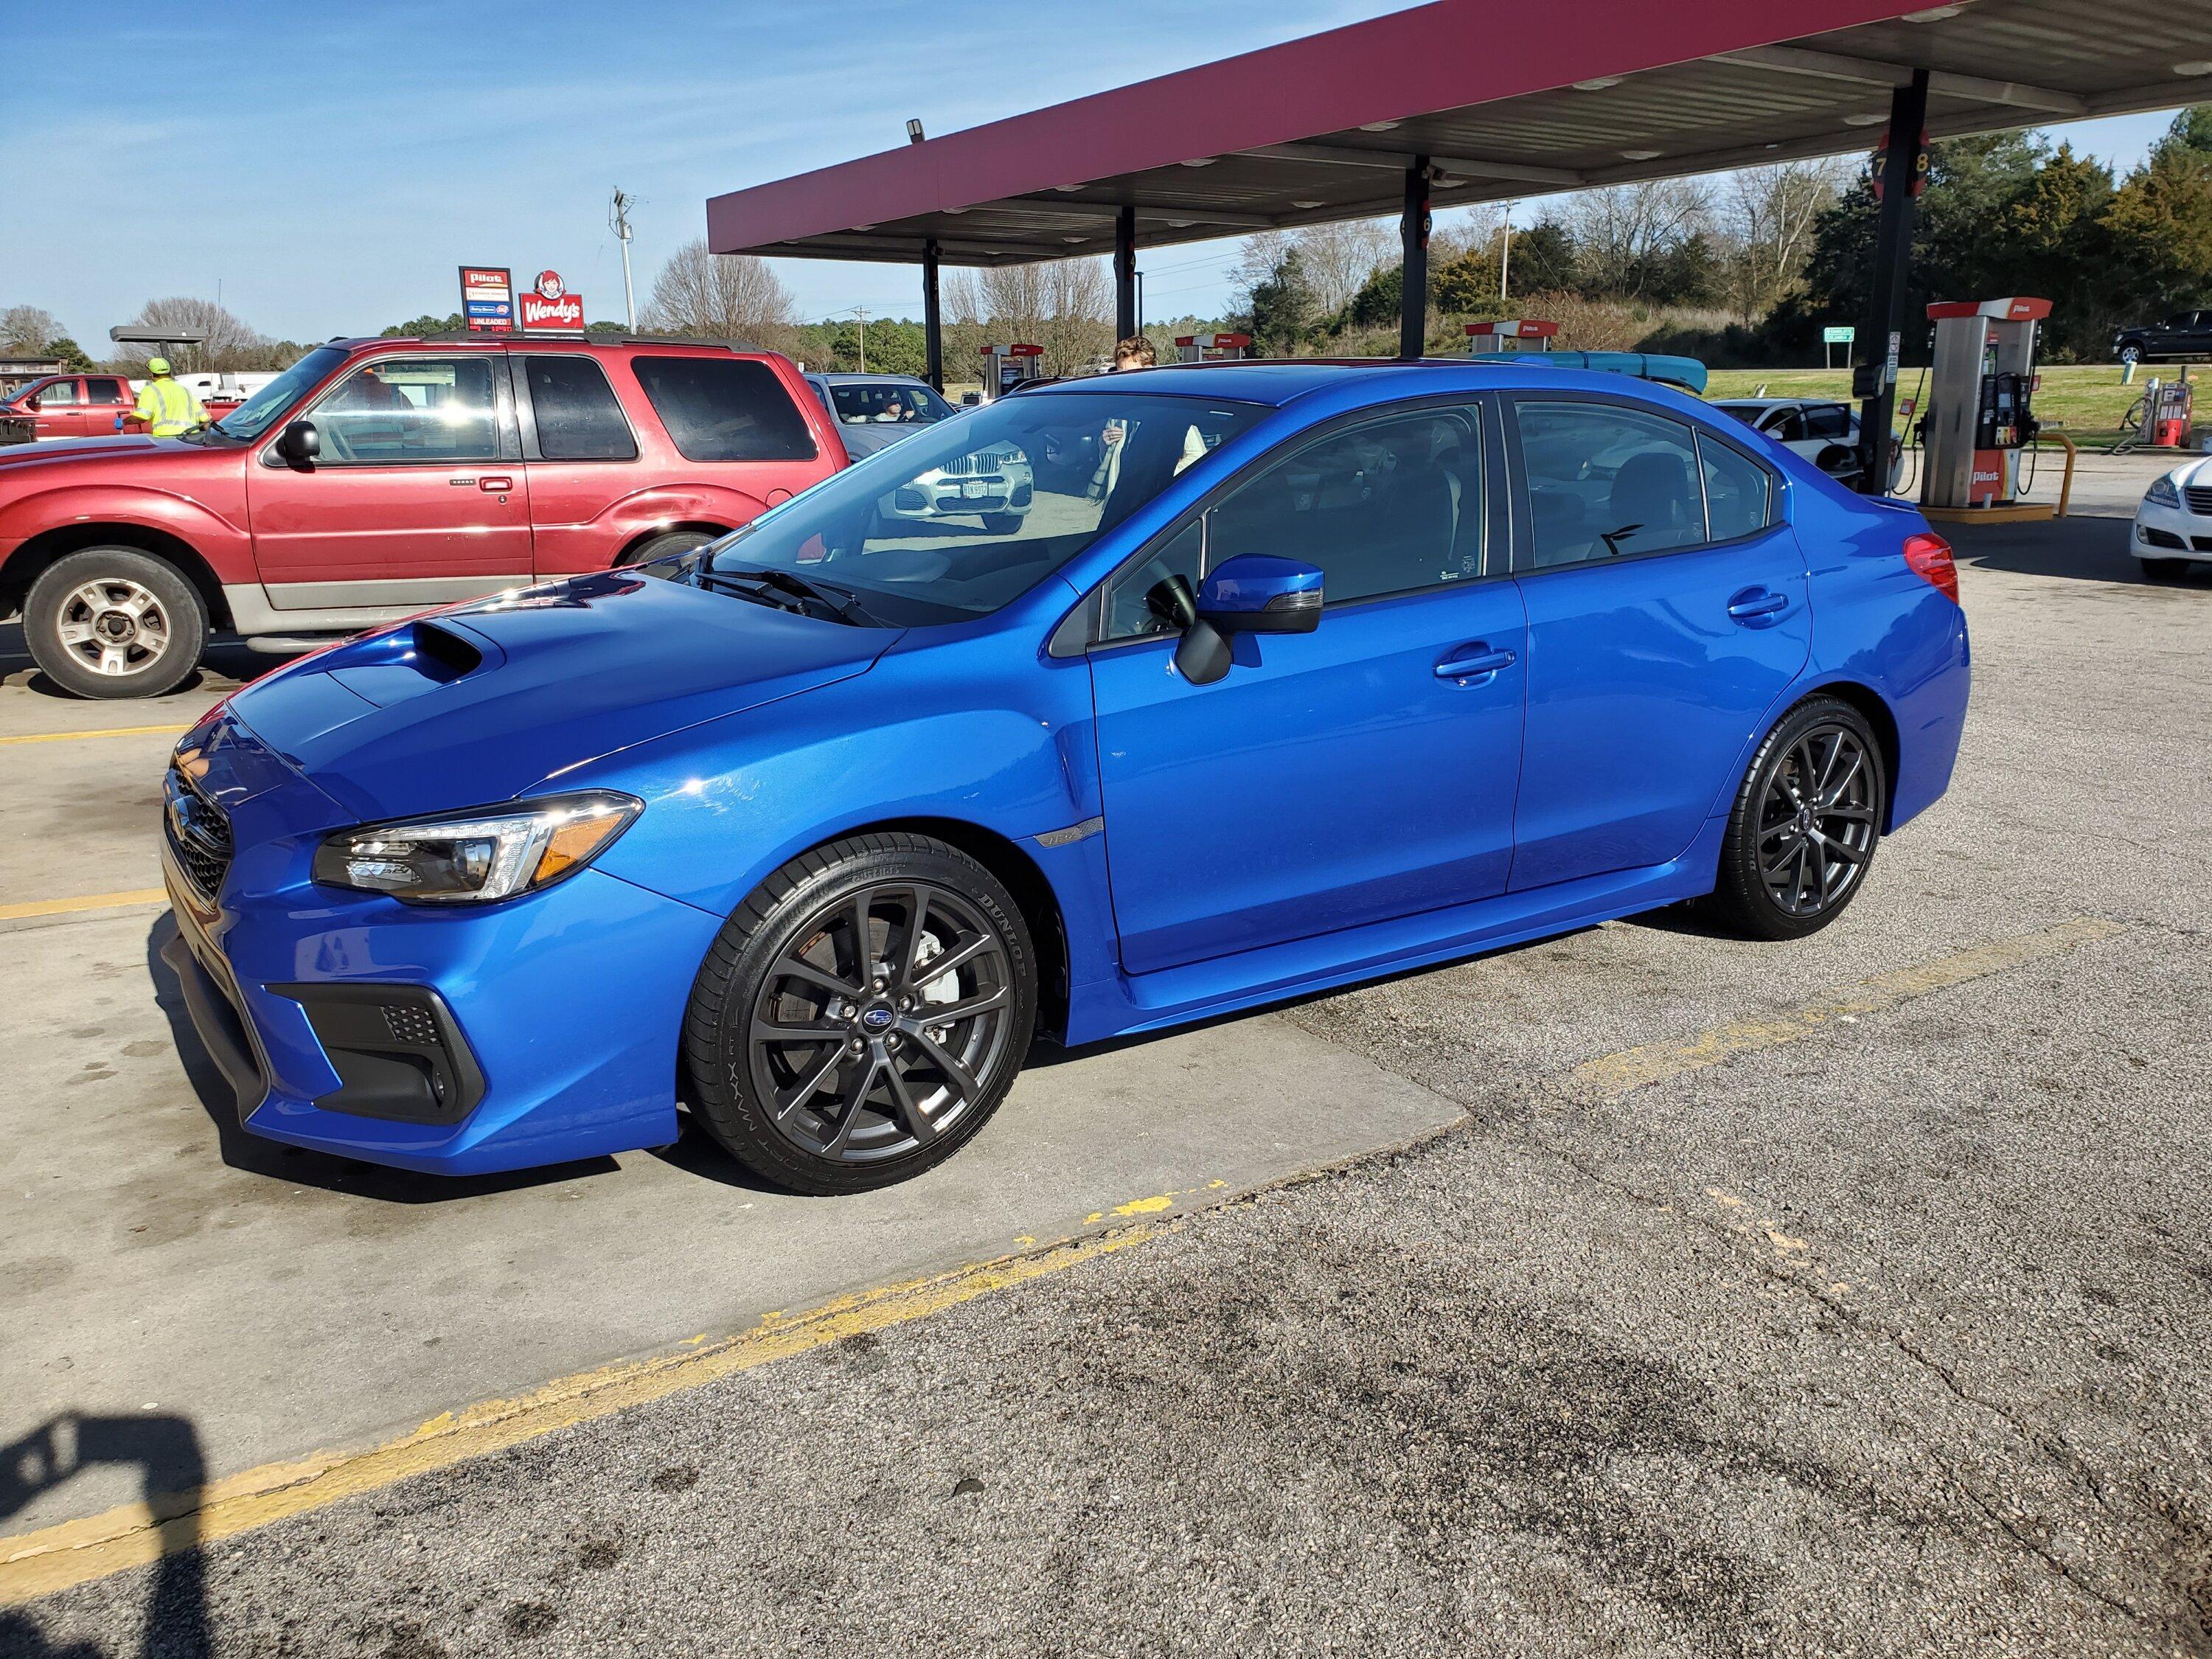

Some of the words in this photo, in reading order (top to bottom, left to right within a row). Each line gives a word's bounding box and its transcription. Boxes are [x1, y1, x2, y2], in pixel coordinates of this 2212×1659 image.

[1876, 157, 1888, 176] 7
[1916, 153, 1929, 173] 8
[1423, 218, 1430, 232] 6
[525, 298, 580, 323] Wendy's
[978, 893, 1026, 976] DUNLOP
[728, 1061, 758, 1132] MAXX
